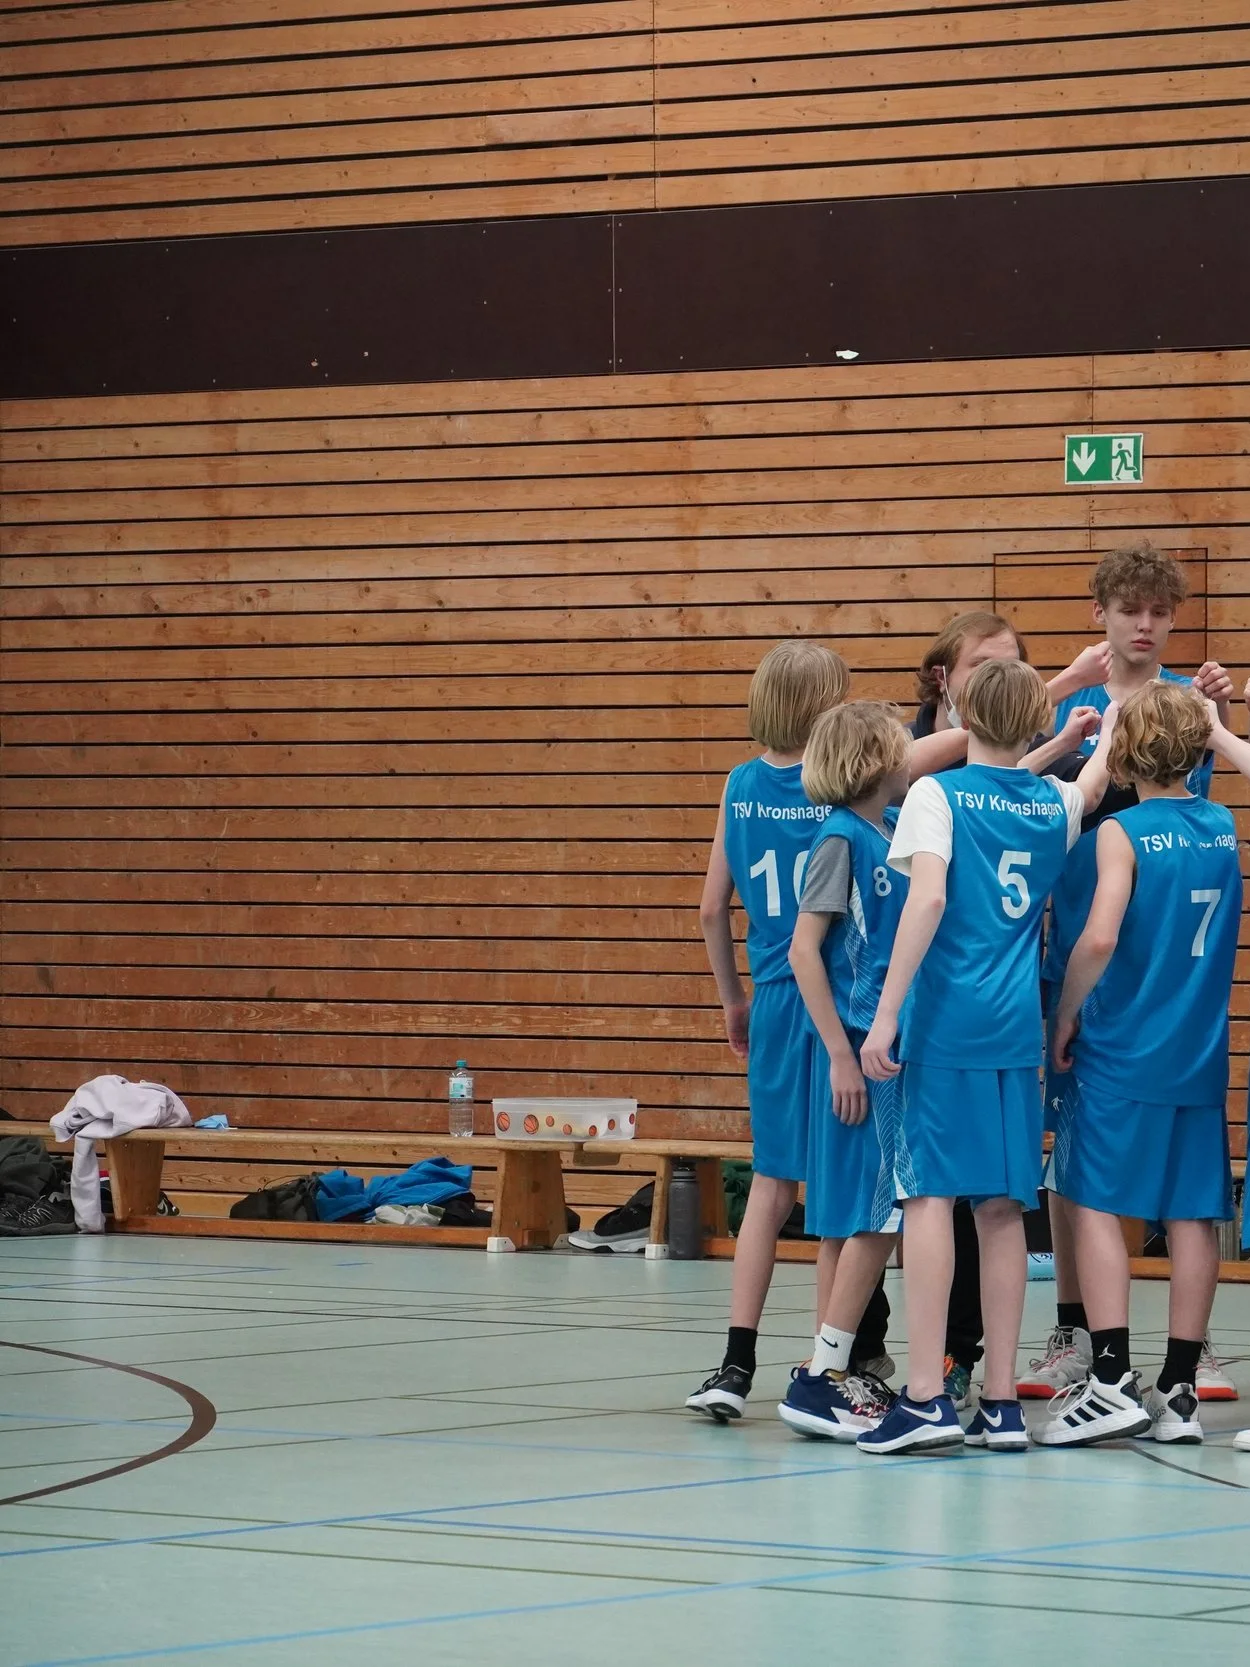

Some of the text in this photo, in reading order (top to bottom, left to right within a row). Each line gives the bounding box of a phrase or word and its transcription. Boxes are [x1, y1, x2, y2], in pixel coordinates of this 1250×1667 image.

[732, 801, 753, 819] TSV
[954, 791, 984, 810] TSV
[1140, 831, 1172, 854] TSV
[873, 866, 892, 897] 8
[997, 850, 1031, 919] 5
[1190, 888, 1222, 957] 7
